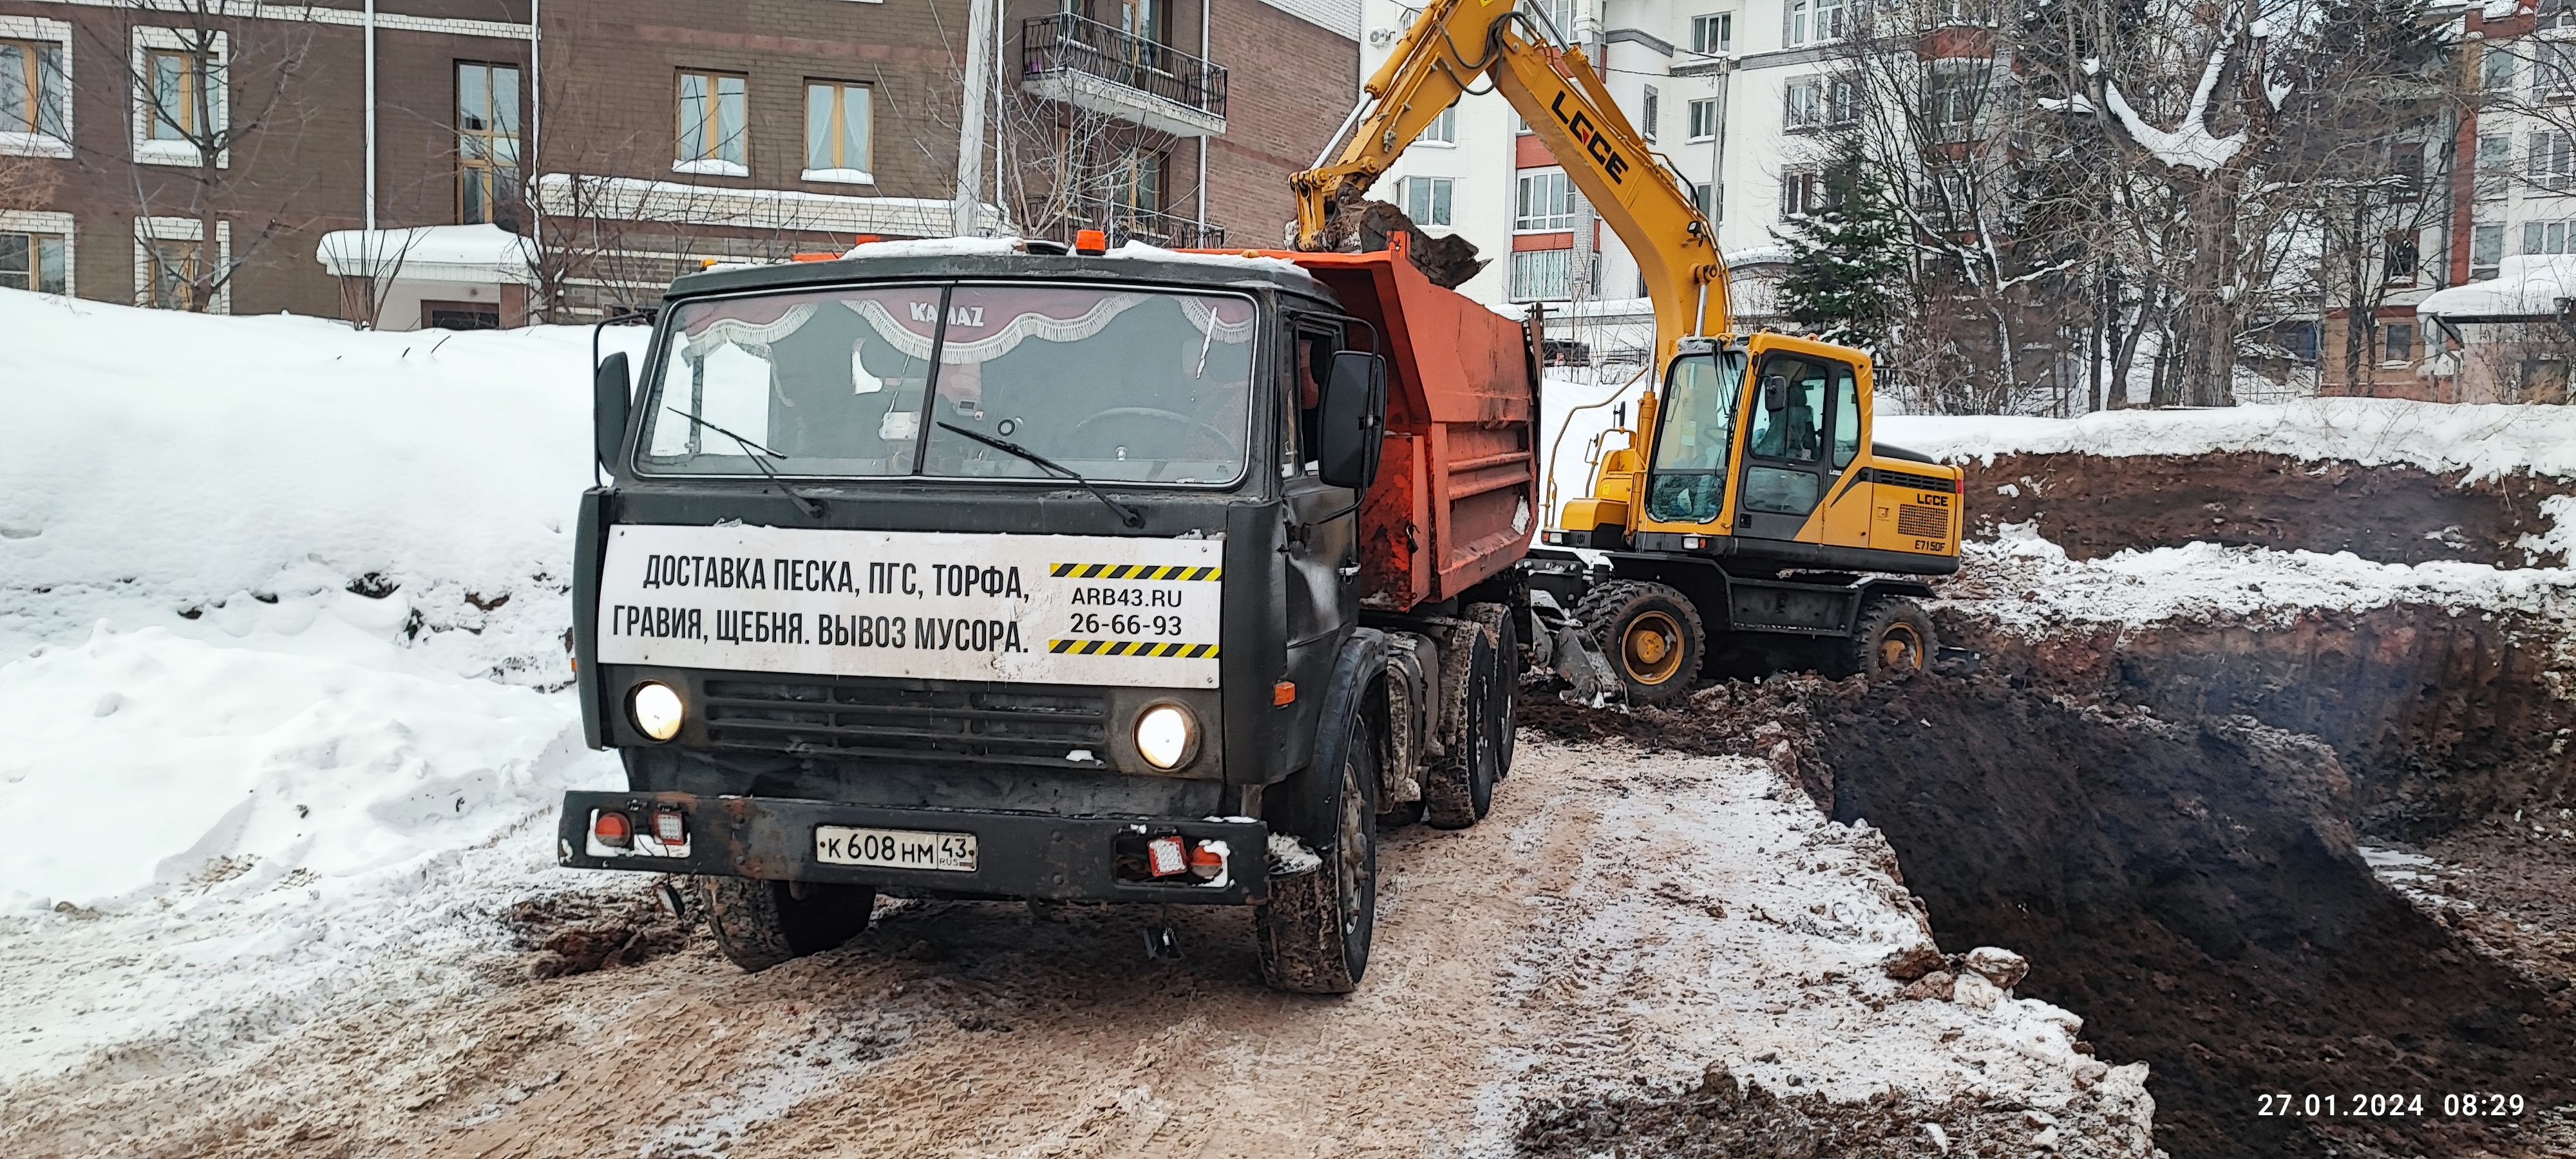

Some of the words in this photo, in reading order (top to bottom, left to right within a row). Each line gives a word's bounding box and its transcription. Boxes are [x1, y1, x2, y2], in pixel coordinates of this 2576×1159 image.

[643, 554, 766, 590] ДОСТАВКА
[774, 559, 860, 598] ПЕСКА,
[869, 562, 923, 600] ПГС,
[933, 563, 1029, 603] ТОРФА,
[1071, 587, 1182, 608] ARB43.RU
[612, 605, 709, 645] ГРАВИЯ,
[716, 609, 810, 646] ЩЕБНЯ.
[819, 614, 906, 648] ВЫВОЗ
[914, 617, 1028, 653] МУСОРА.
[1070, 613, 1182, 636] 26-66-93
